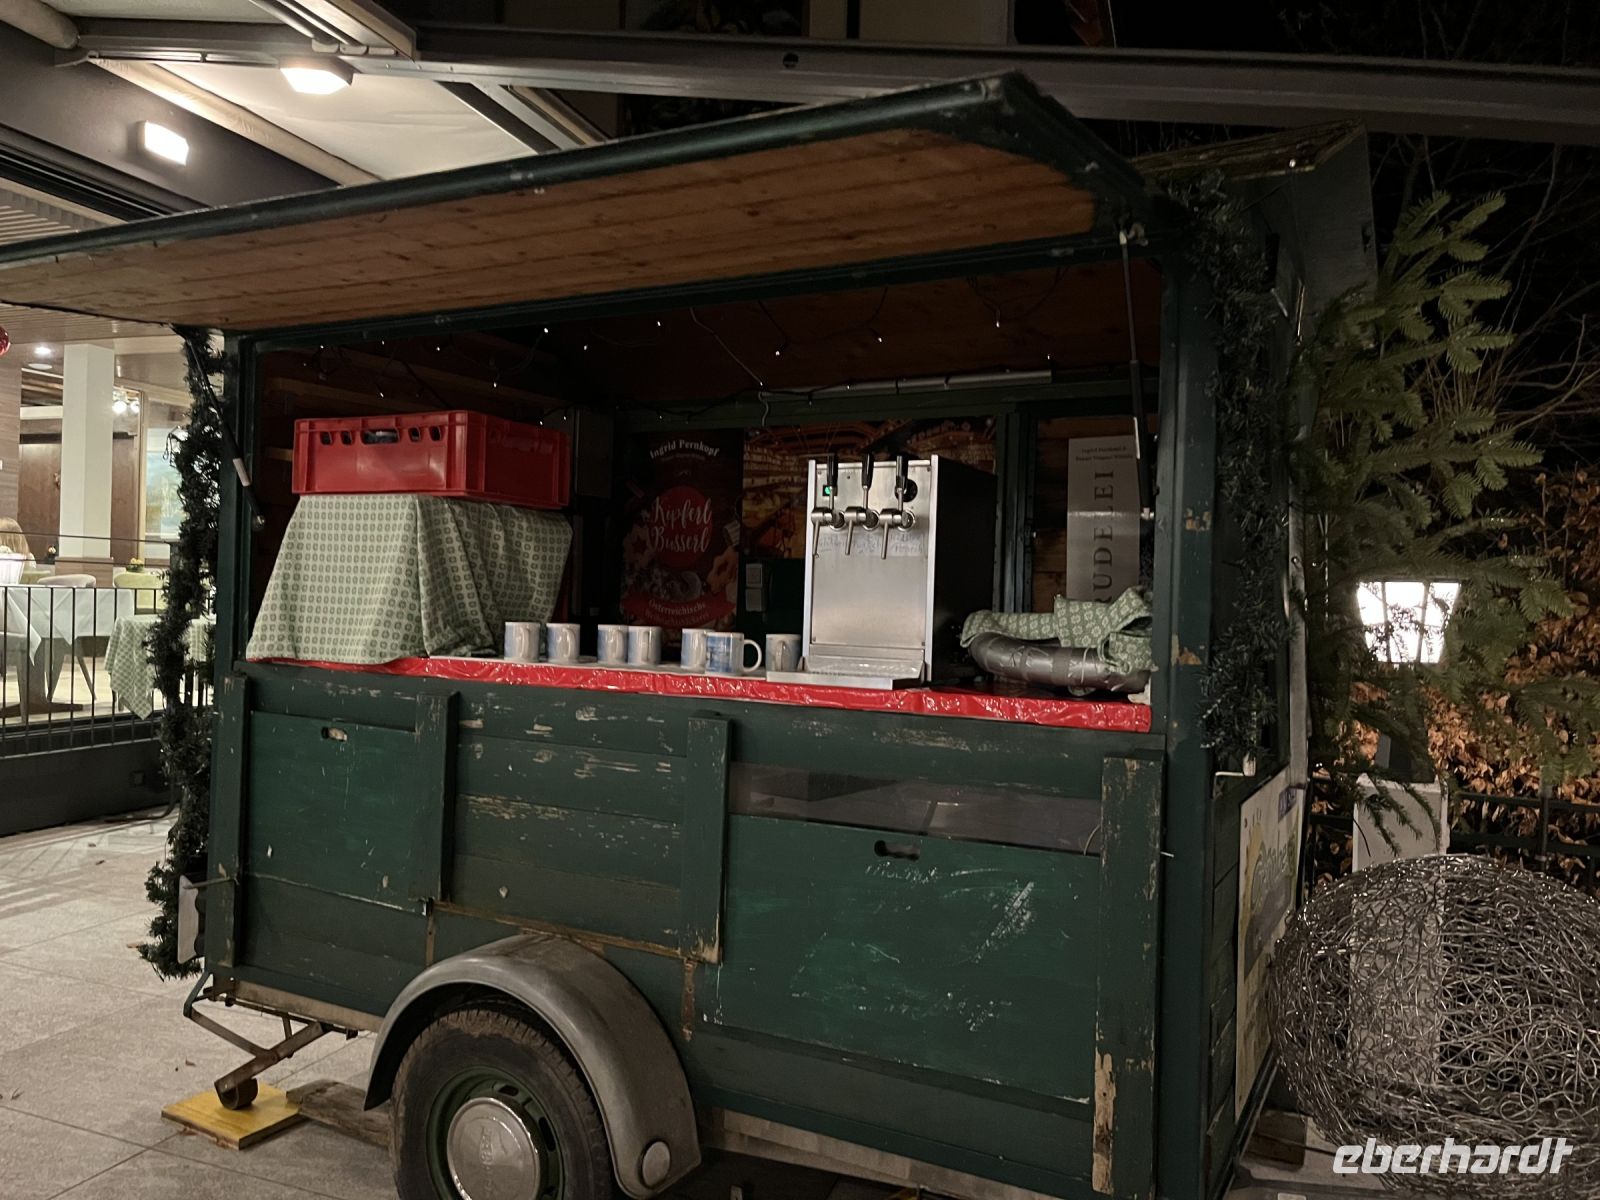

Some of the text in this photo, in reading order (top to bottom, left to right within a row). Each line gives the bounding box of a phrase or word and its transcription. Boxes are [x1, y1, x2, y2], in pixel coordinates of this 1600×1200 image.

[649, 439, 676, 460] Ingrid
[679, 439, 720, 457] Pernkopf
[652, 496, 713, 530] Kipferl
[652, 526, 710, 553] Busserl
